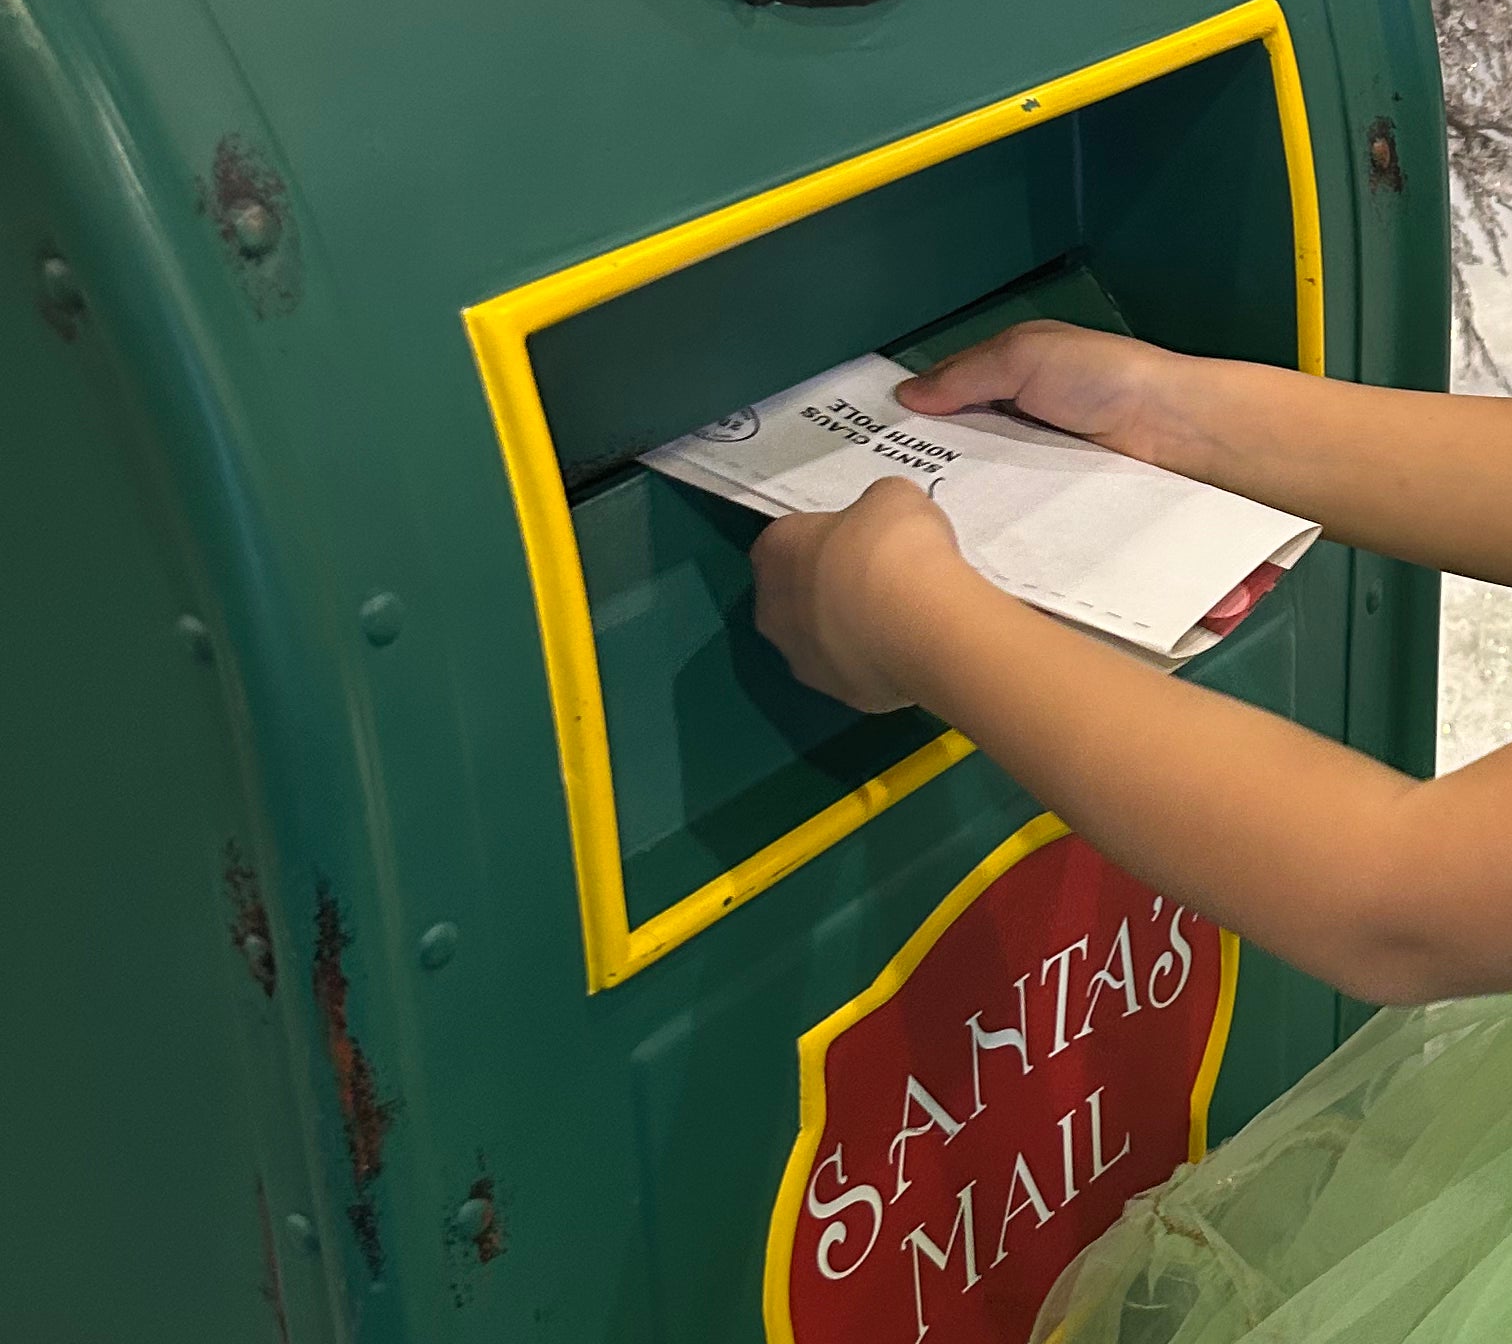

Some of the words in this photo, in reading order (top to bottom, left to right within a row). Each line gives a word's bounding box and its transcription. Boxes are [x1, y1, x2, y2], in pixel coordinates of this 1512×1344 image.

[800, 406, 870, 445] CLAUS
[827, 398, 887, 433] POLE
[873, 443, 944, 473] SANTA
[885, 430, 962, 463] NORTH
[808, 896, 1198, 1280] SANTA'S
